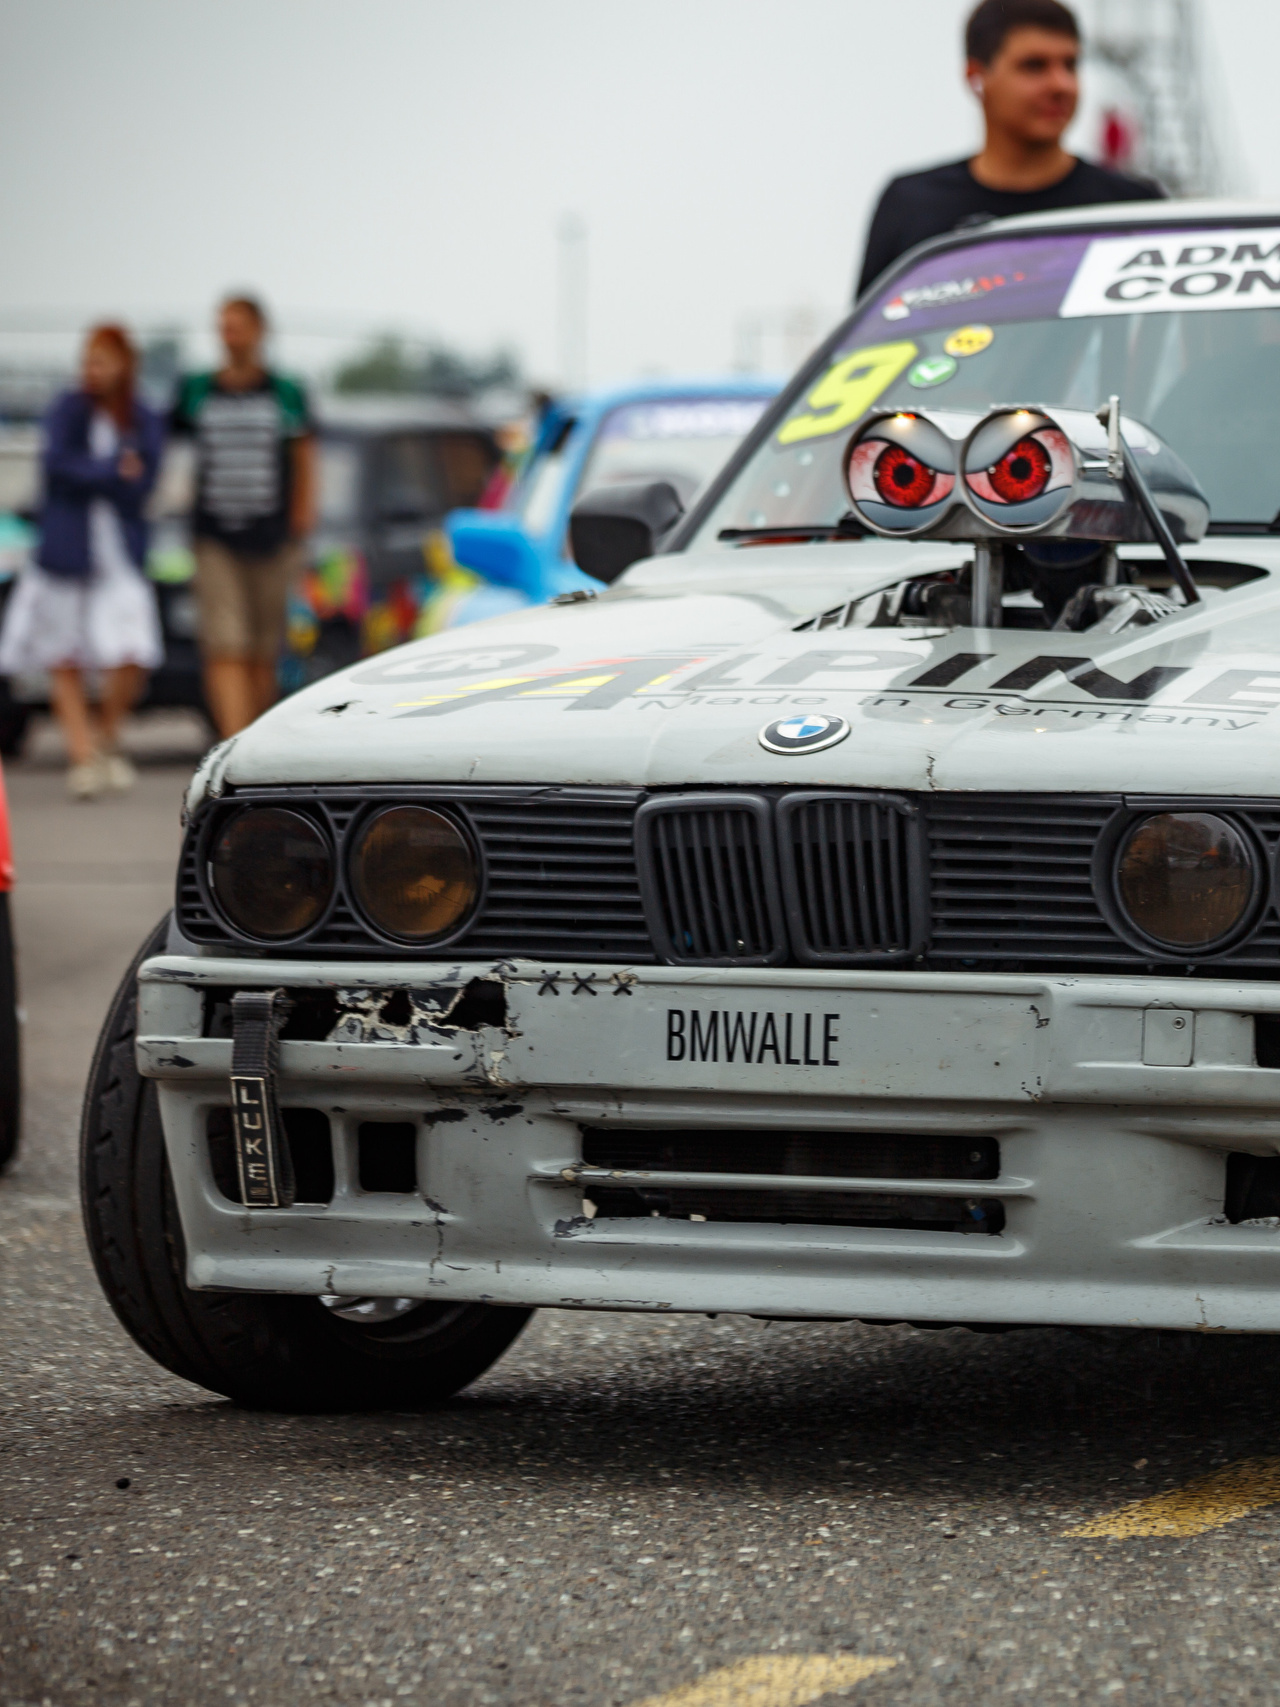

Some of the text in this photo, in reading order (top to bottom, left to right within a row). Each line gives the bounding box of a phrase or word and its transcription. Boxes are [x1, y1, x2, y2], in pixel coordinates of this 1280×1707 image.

[777, 339, 919, 446] 9
[637, 693, 1259, 731] Made in Germany
[666, 1008, 841, 1067] BMWALLE
[239, 1085, 268, 1181] LUKE
